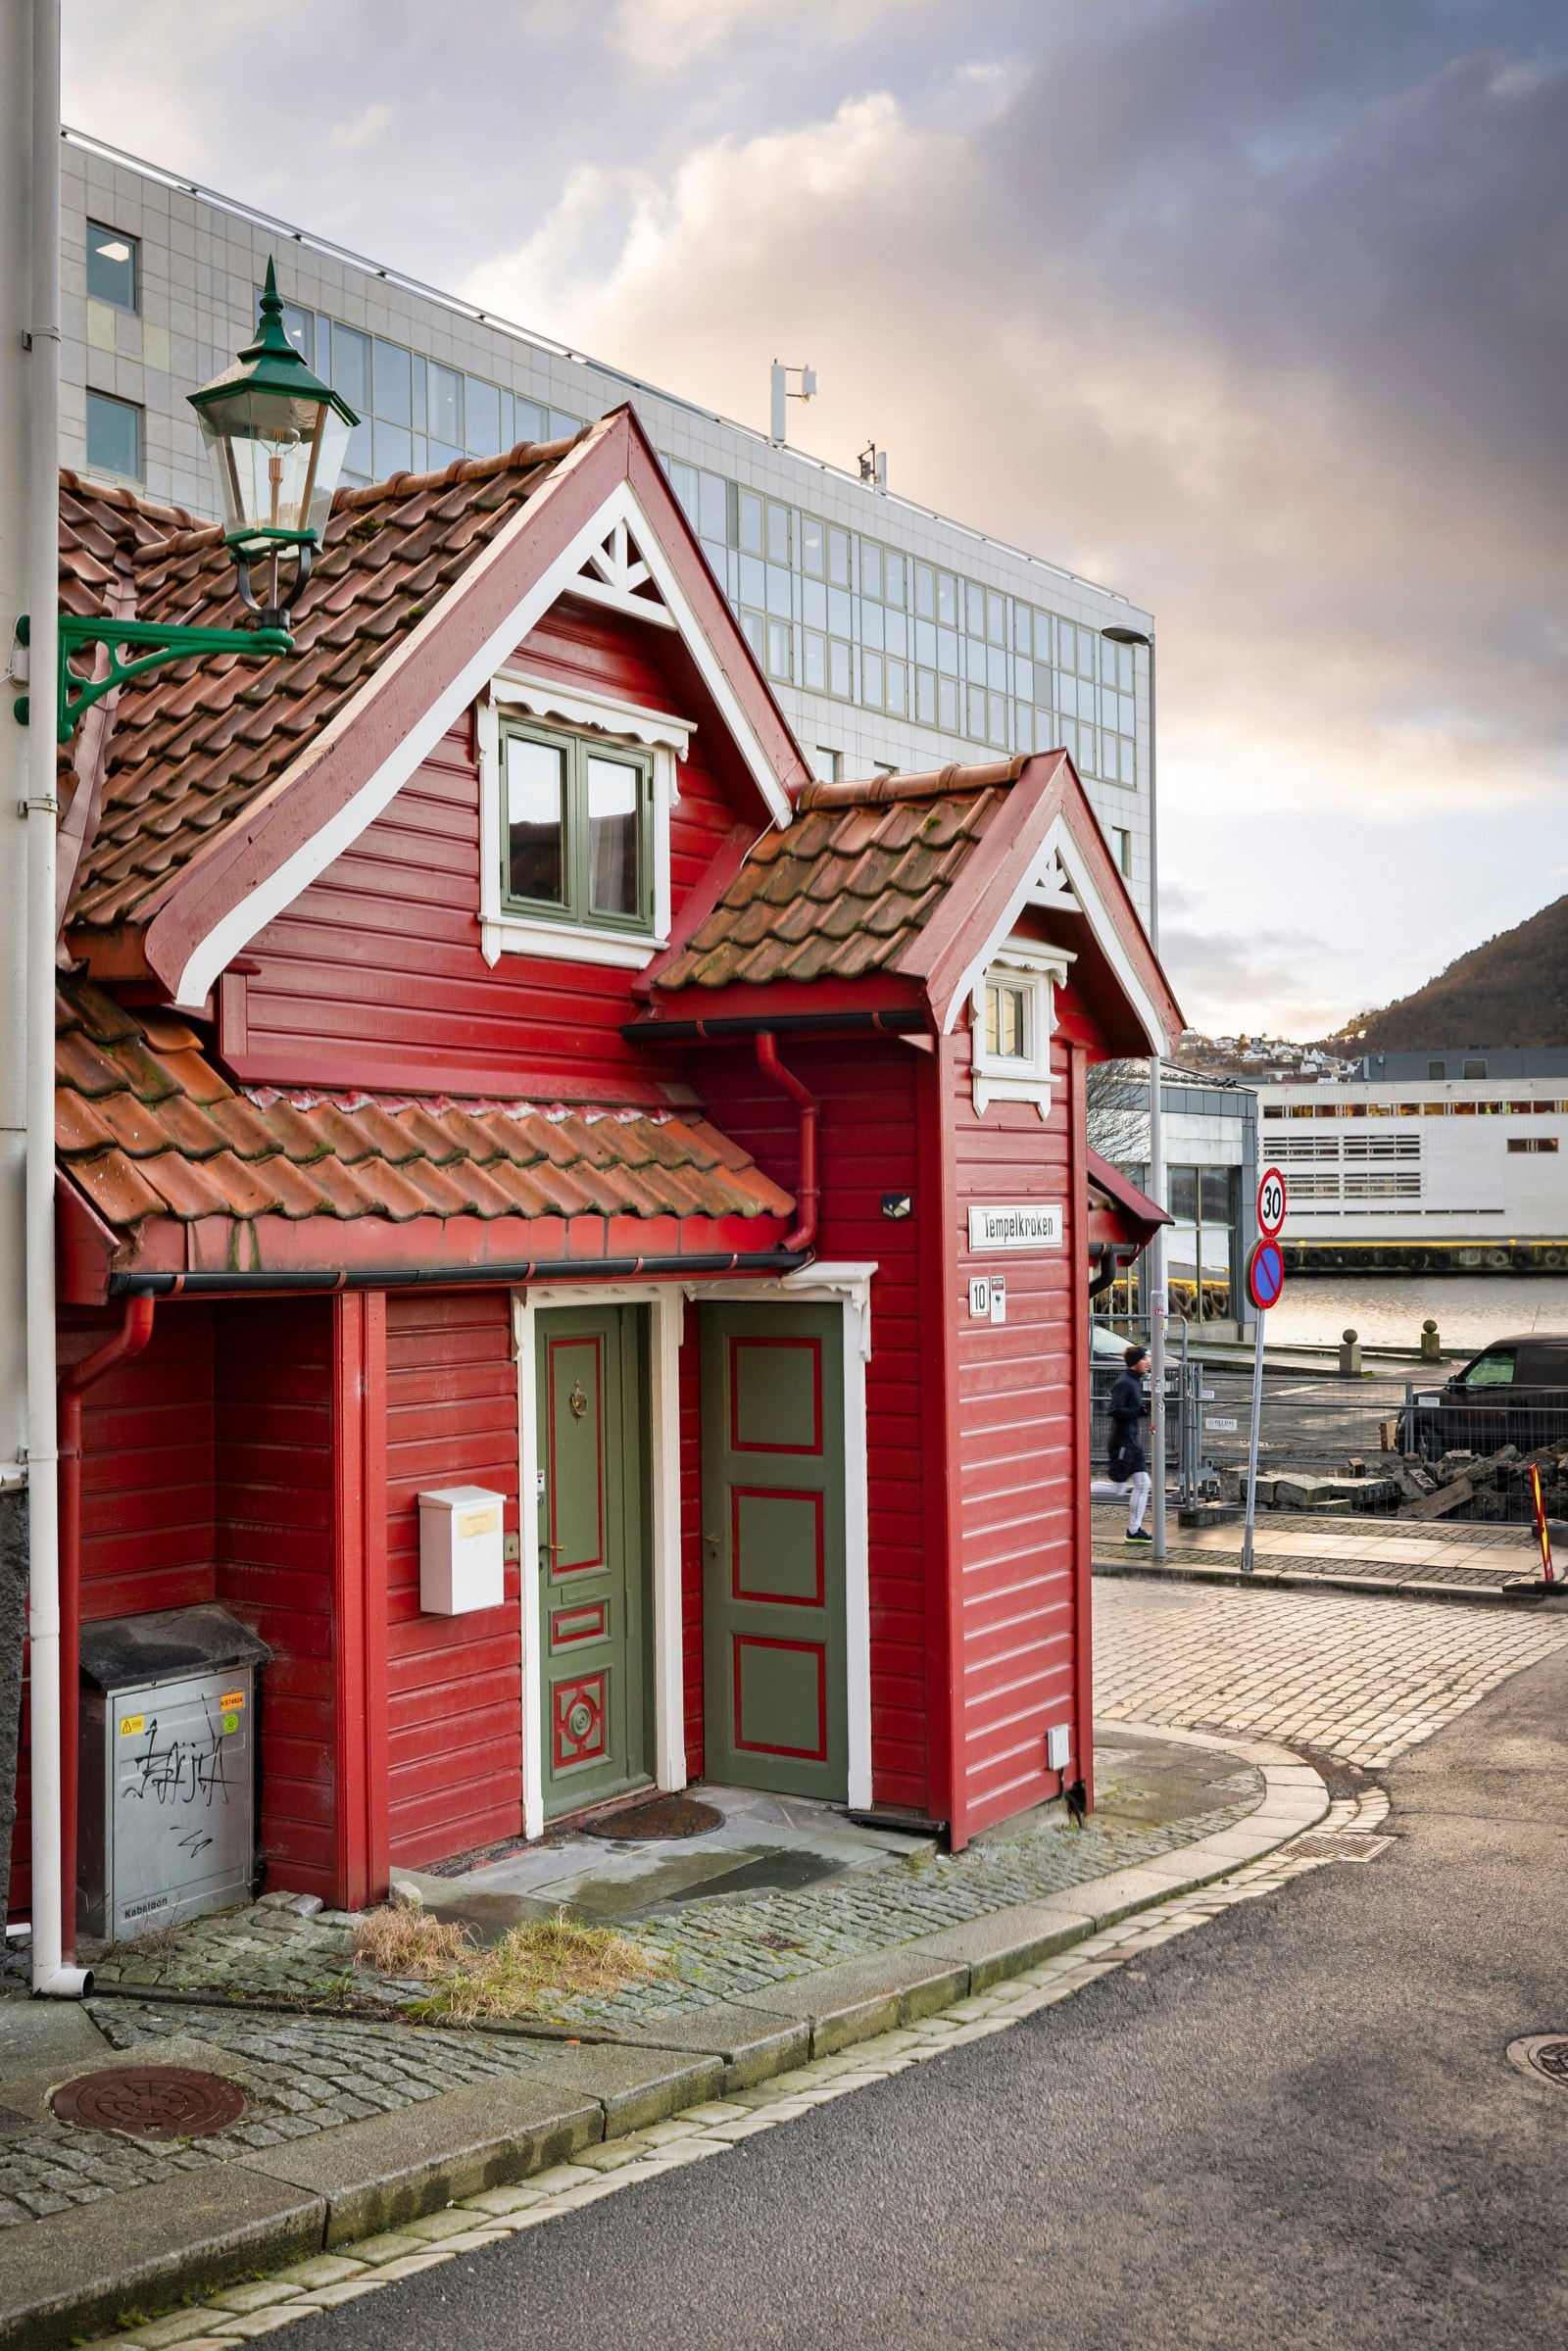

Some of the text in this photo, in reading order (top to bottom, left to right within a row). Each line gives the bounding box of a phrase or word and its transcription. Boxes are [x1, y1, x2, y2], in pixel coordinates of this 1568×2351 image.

[1262, 1185, 1281, 1219] 30
[982, 1211, 1054, 1244] Tempelkroken
[973, 1284, 986, 1310] 10
[124, 1898, 168, 1919] Kabeldon
